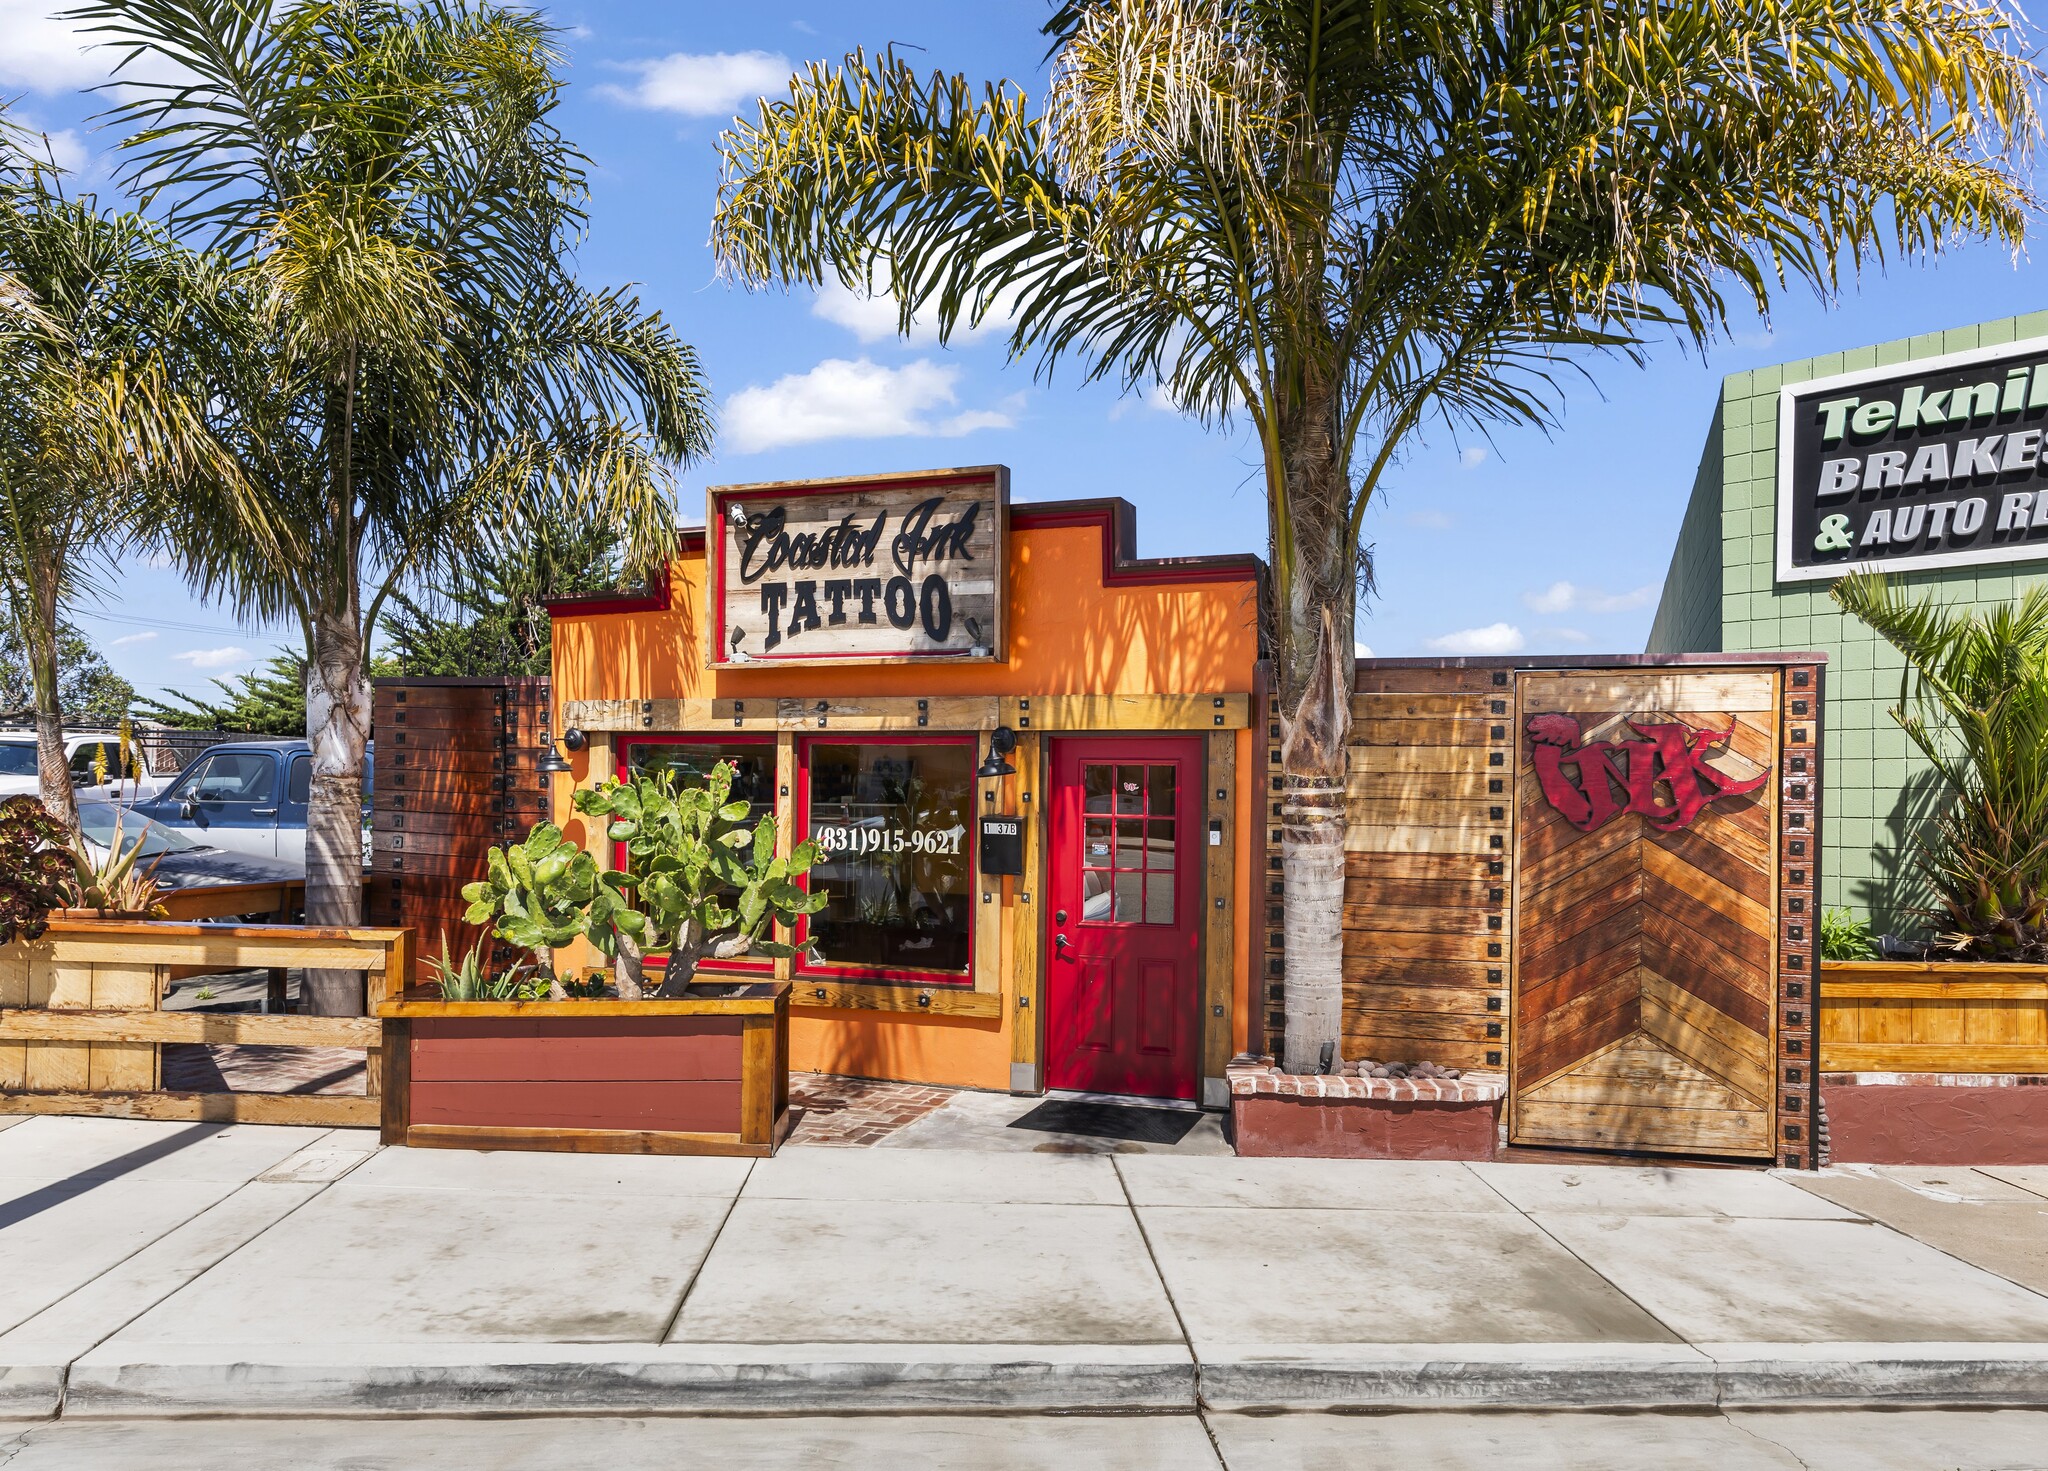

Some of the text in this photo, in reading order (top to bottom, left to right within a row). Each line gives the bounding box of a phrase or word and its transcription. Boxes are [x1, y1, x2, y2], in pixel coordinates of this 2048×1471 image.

[1817, 429, 2048, 497] BRAKE
[740, 497, 980, 584] Coastal Ink
[1814, 513, 1854, 552] &
[1860, 497, 1988, 547] AUTO
[760, 574, 952, 653] TATTOO
[816, 825, 961, 856] (831)915-9621
